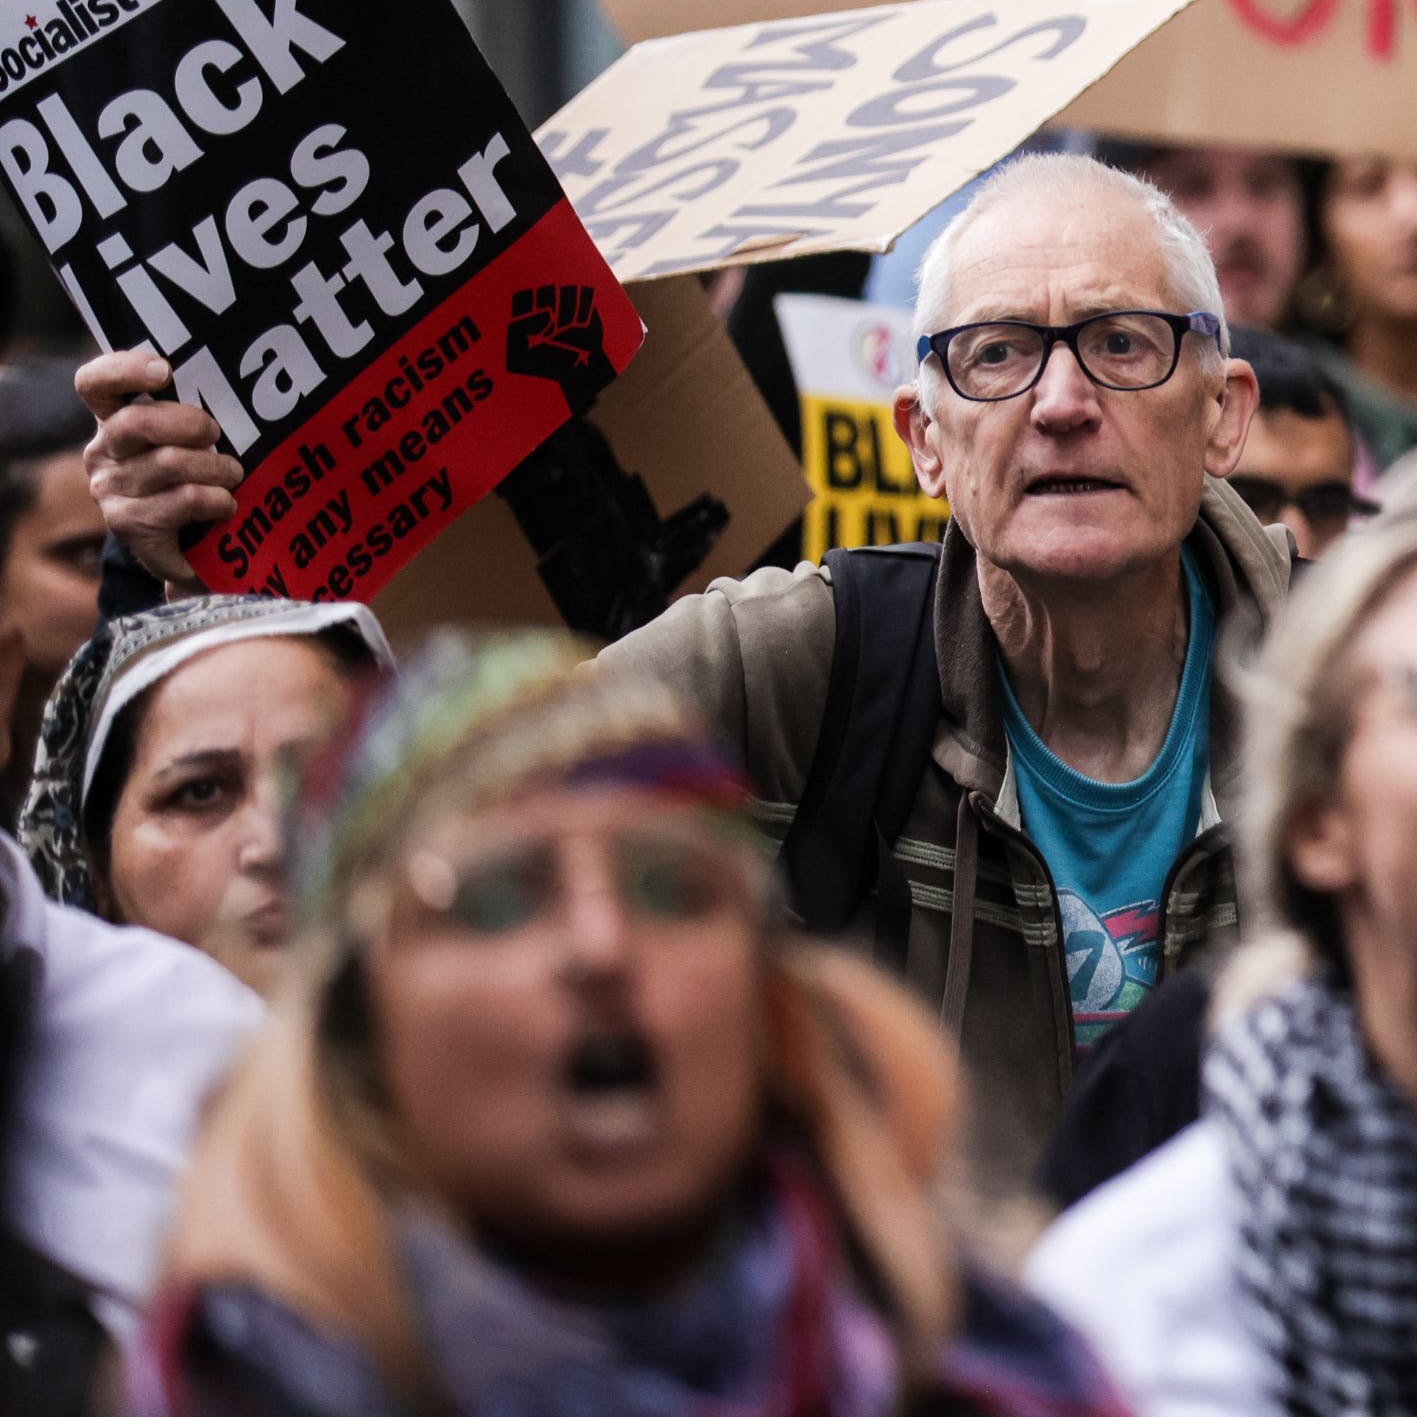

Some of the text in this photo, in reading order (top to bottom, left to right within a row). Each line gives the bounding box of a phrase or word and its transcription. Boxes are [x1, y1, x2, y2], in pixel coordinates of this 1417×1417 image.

[218, 315, 482, 579] Smash racism
[288, 489, 352, 569] any
[360, 368, 494, 496] means
[826, 411, 920, 494] BL
